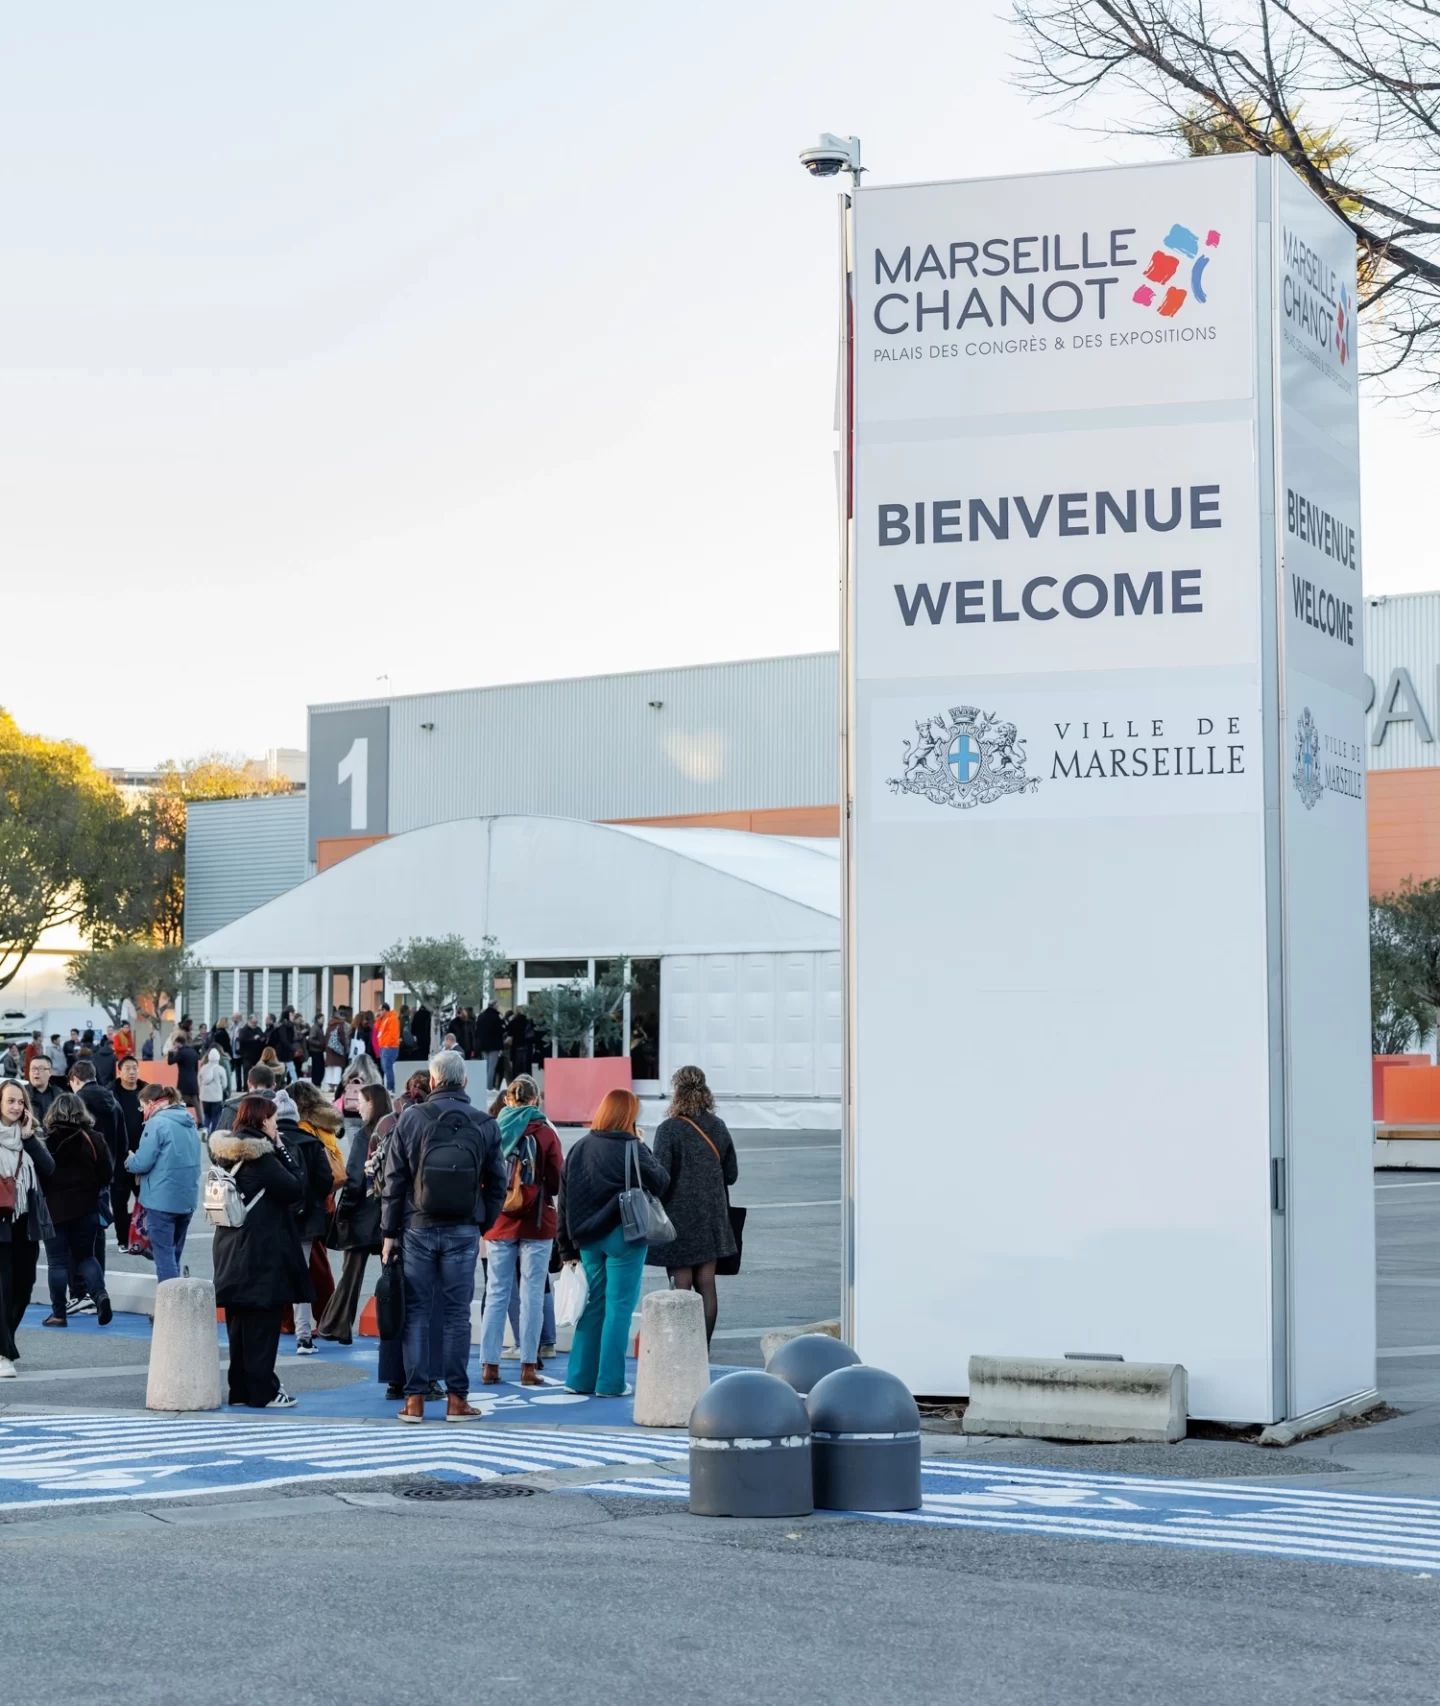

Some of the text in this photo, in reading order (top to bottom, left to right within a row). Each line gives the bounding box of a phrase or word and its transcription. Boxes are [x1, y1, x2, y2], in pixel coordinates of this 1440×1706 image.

[875, 228, 1137, 285] MARSEILLE
[1283, 224, 1337, 309] MARSEILLE
[874, 277, 1119, 335] CHANOT
[1283, 274, 1334, 353] CHANOT
[874, 326, 1217, 362] PALAIS DES CONGRÈS & DES EXPOSITIONS
[878, 484, 1222, 547] BIENVENUE
[1287, 488, 1356, 571] BIENVENUE
[894, 569, 1203, 626] WELCOME
[1292, 573, 1354, 647] WELCOME
[1054, 717, 1240, 740] VILLE DE
[338, 737, 368, 830] 1
[1050, 745, 1245, 779] MARSEILLE
